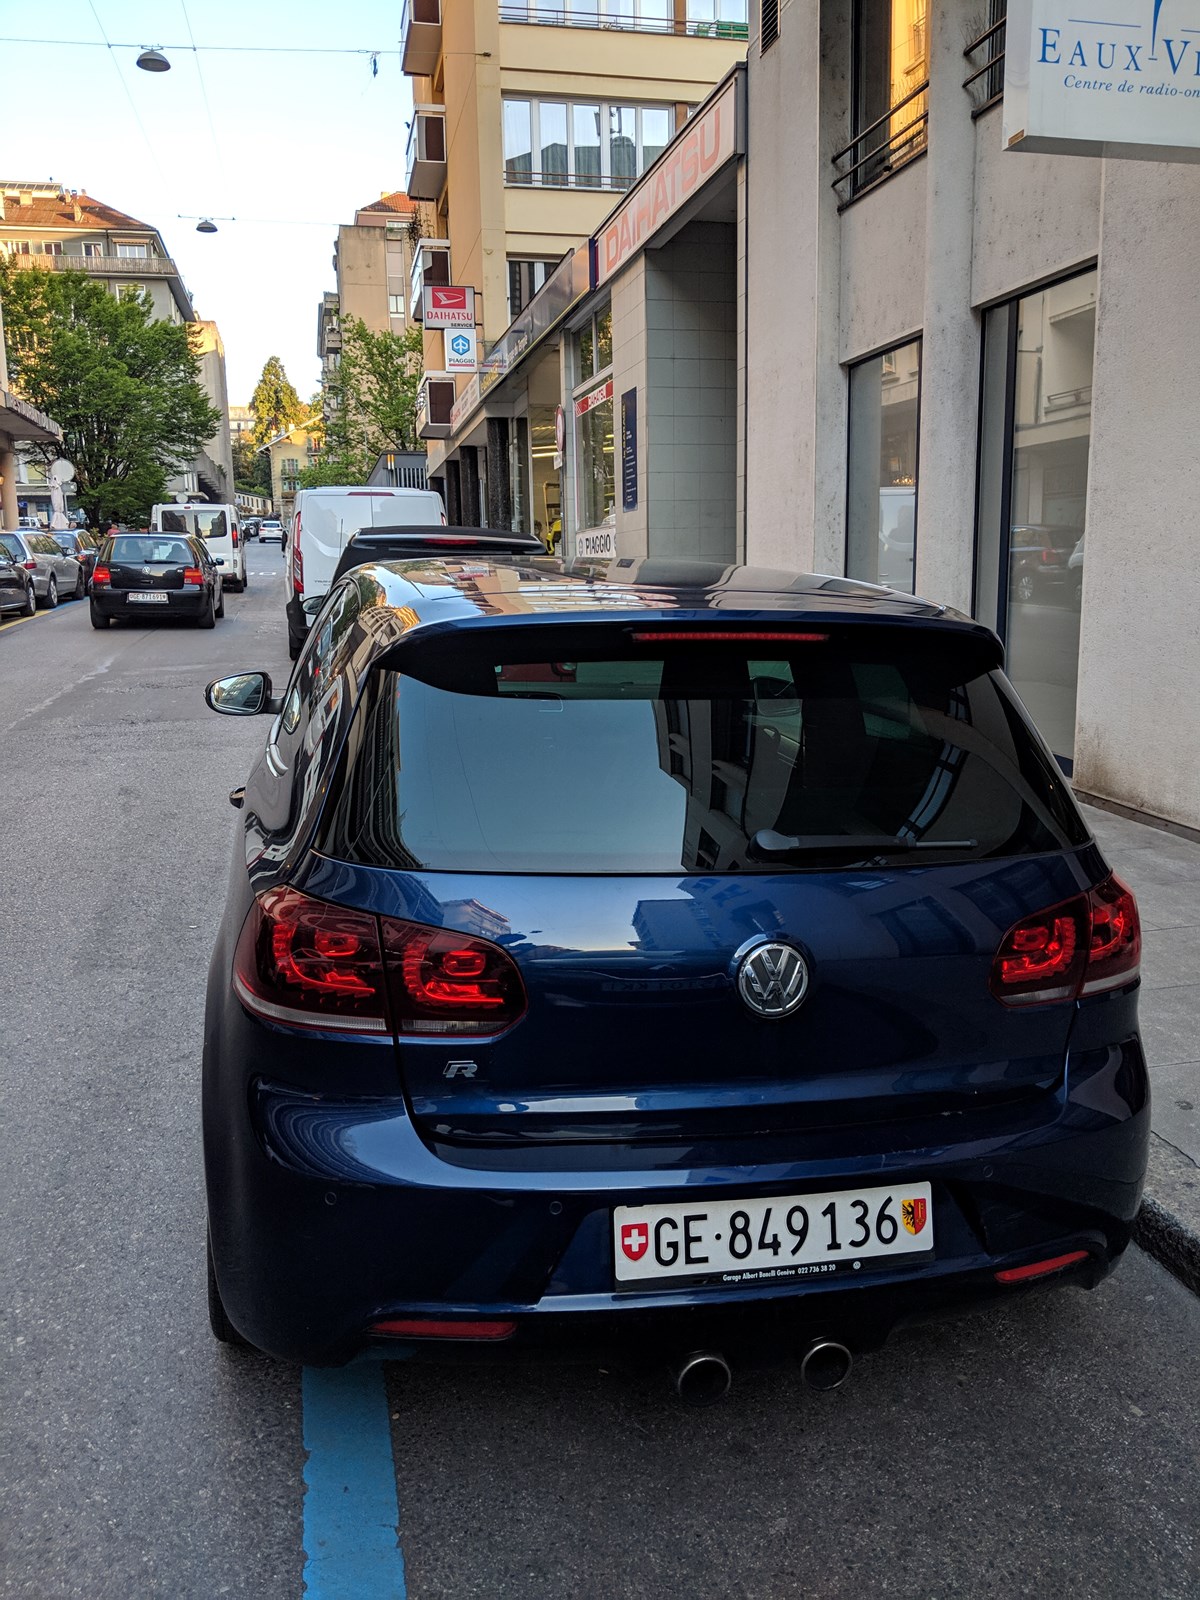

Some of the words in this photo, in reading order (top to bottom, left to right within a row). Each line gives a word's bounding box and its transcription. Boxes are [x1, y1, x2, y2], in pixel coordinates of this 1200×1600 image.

[1064, 74, 1112, 91] Centre
[1117, 79, 1134, 93] de
[605, 106, 721, 273] DAIHATSU
[426, 310, 473, 321] DAIHATSU
[585, 533, 611, 555] PIAGGIO
[809, 1265, 820, 1274] 736
